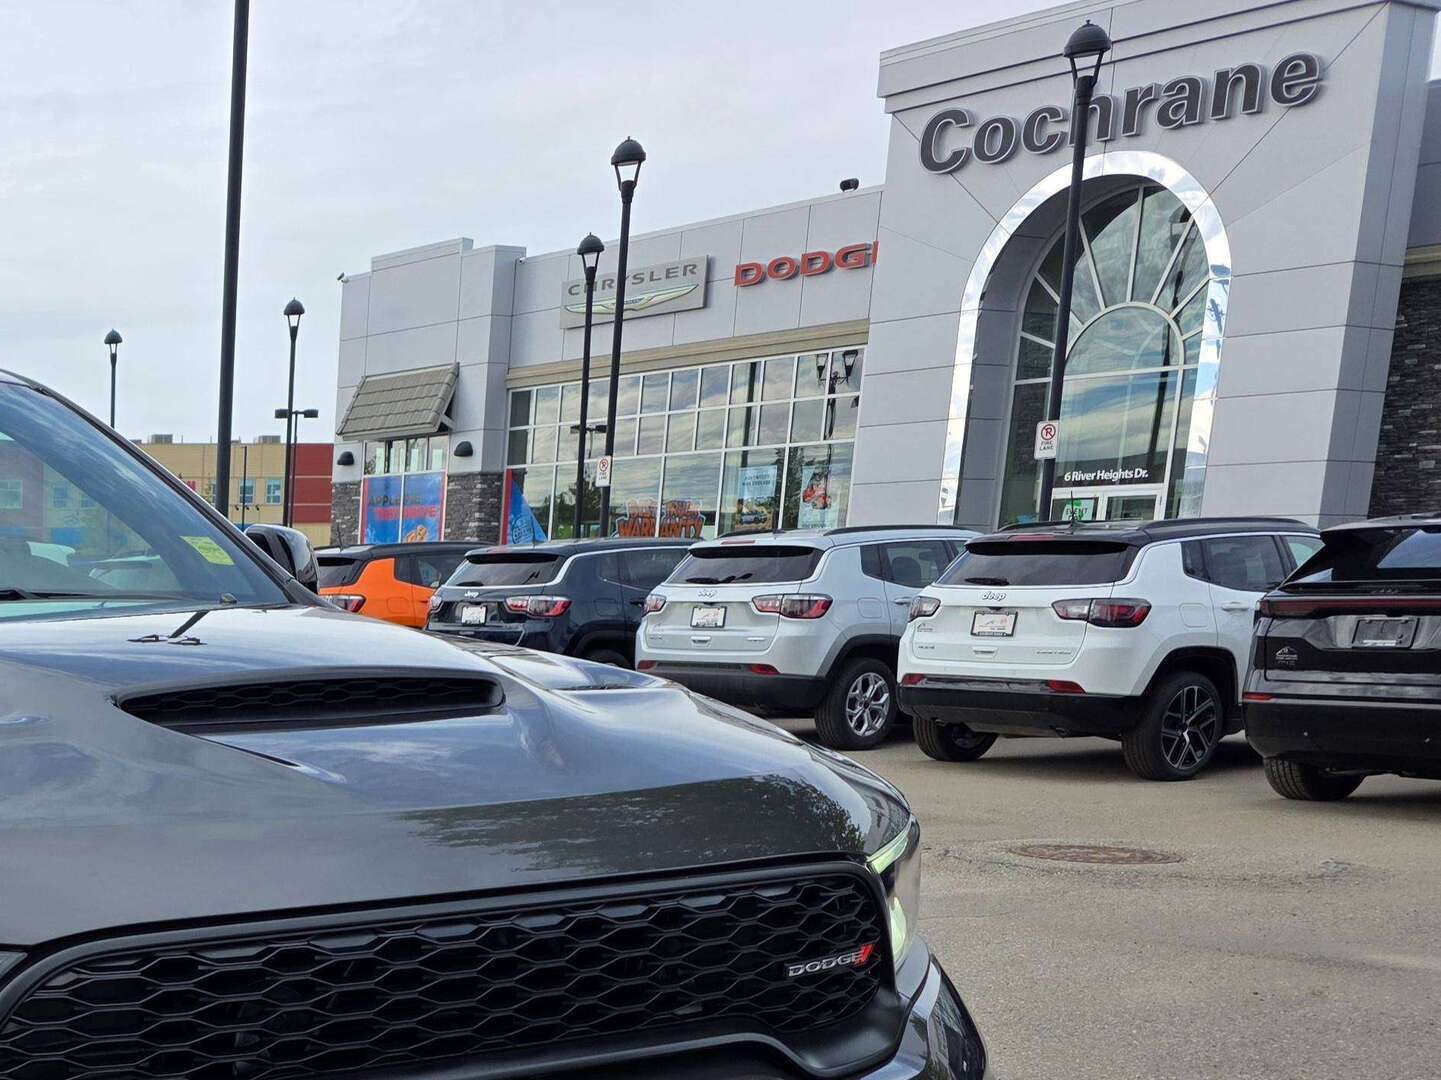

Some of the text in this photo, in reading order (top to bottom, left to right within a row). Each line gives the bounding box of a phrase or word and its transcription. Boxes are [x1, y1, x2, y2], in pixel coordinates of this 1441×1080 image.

[918, 50, 1328, 175] Cochrane
[567, 263, 698, 297] CHRSLER
[734, 241, 879, 287] DODG
[1064, 467, 1149, 482] 6 River Heights Dr.
[788, 950, 864, 977] DODGE
